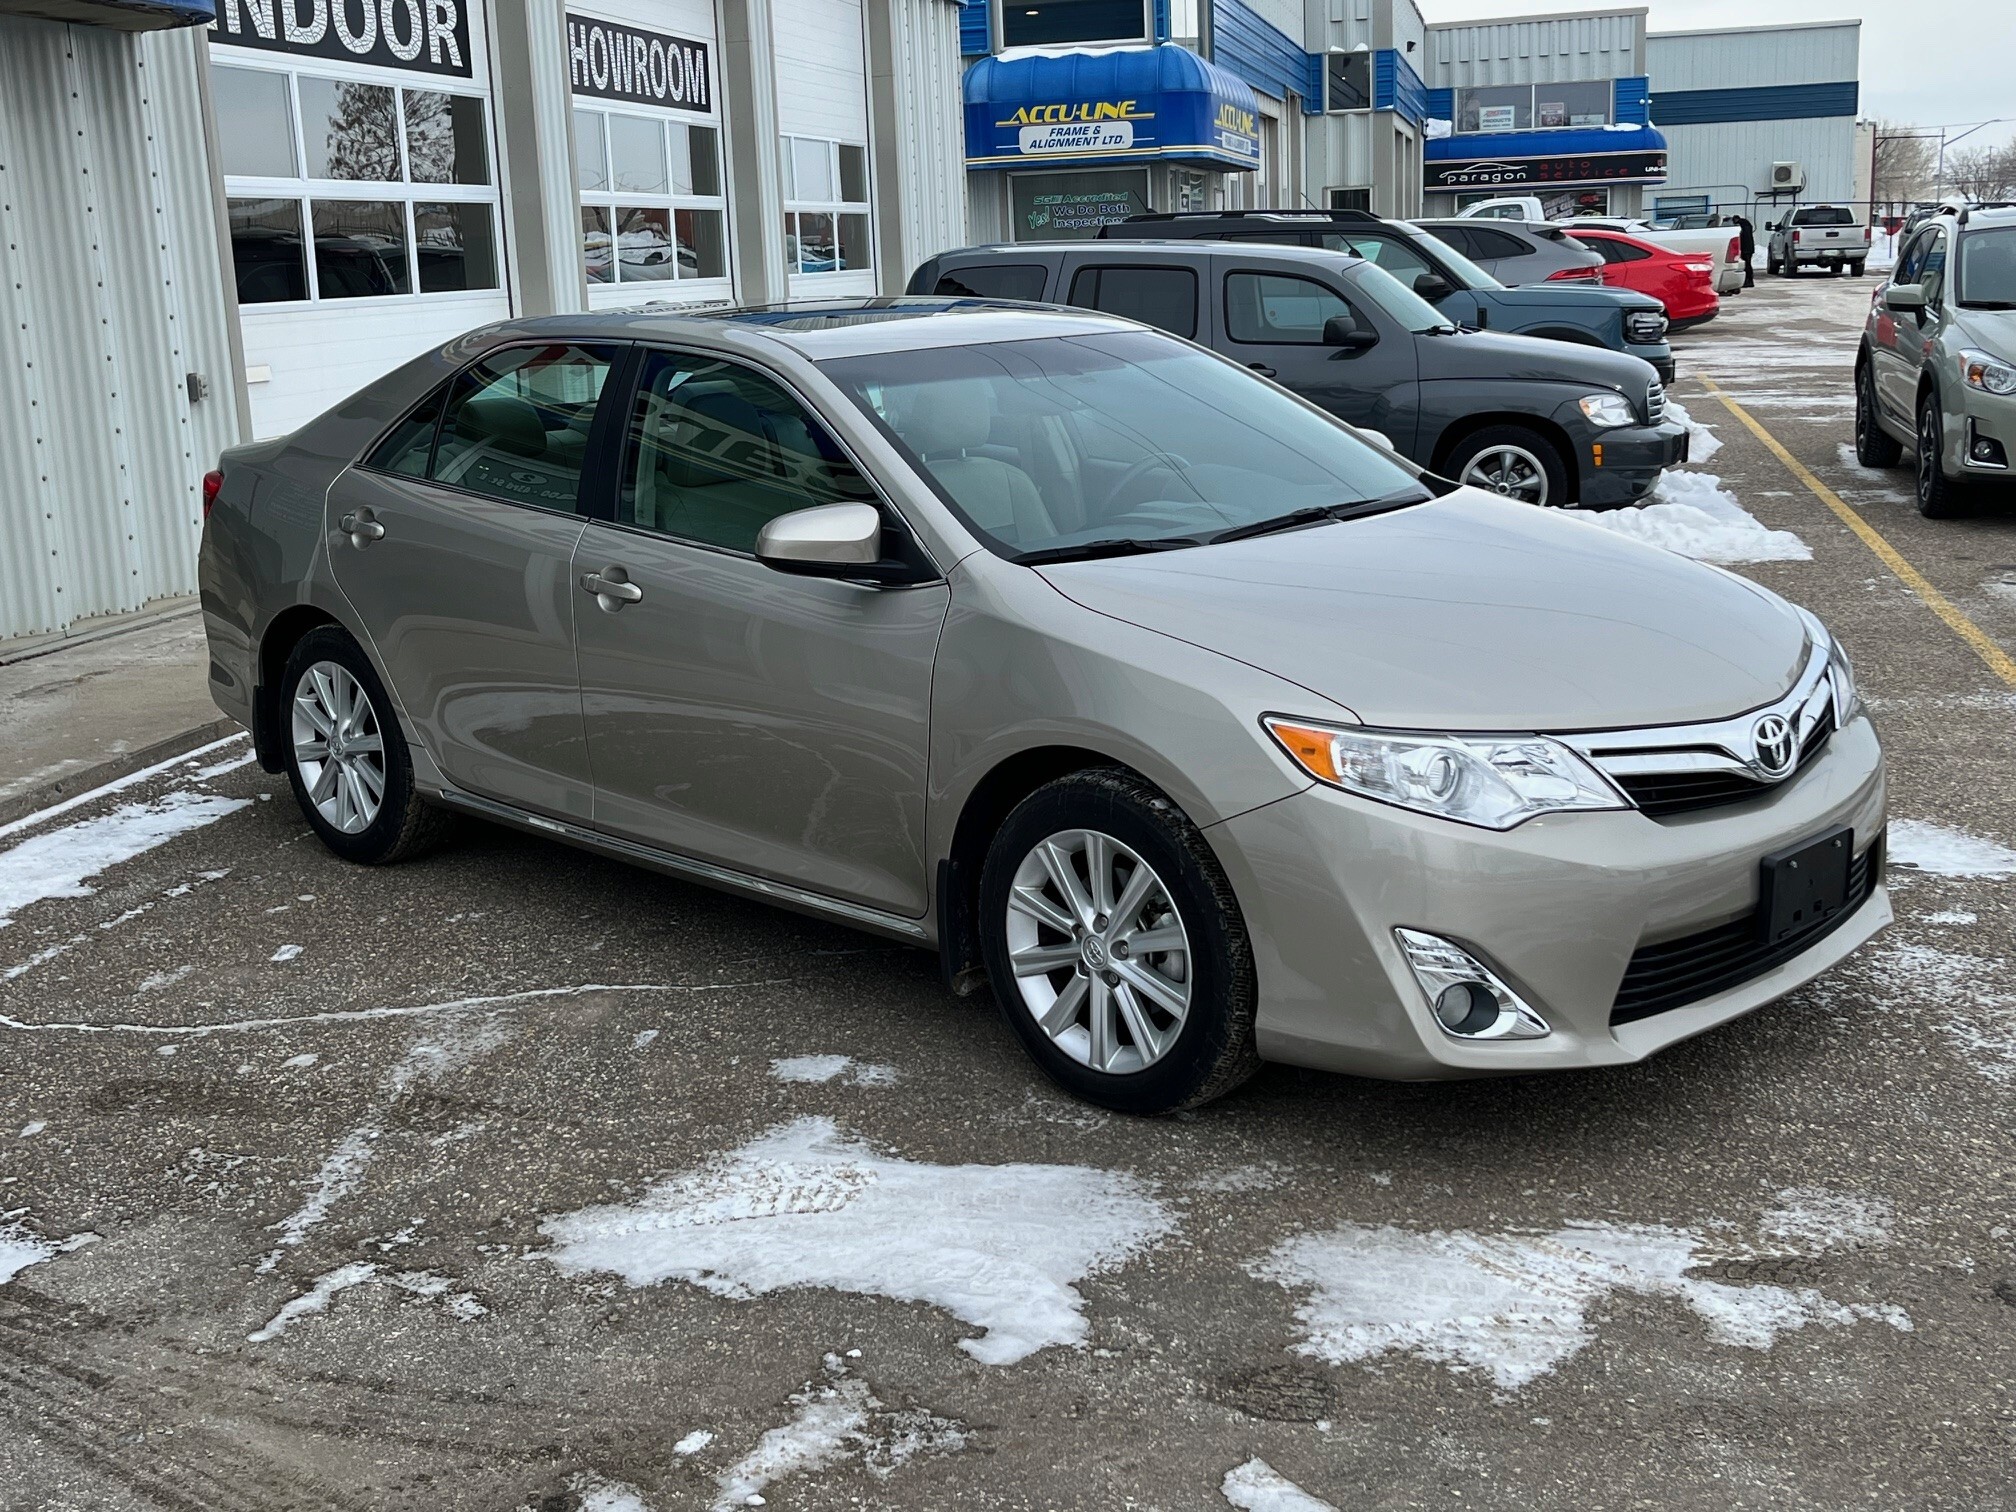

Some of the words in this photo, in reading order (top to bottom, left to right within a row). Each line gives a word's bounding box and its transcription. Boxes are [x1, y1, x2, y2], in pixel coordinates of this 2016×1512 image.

[207, 0, 463, 68] NDOOR
[569, 22, 707, 105] HOWROOM
[996, 100, 1155, 126] ACCU-LINE
[1049, 126, 1090, 137] FRAME
[1093, 125, 1101, 135] &
[1029, 136, 1099, 149] ALIGNMENT
[1540, 159, 1591, 170] auto
[1447, 171, 1527, 185] paragon
[1540, 167, 1629, 180] service
[1052, 205, 1075, 216] We
[1077, 204, 1096, 215] Do
[1099, 203, 1131, 214] Both
[1028, 205, 1050, 230] Yes!
